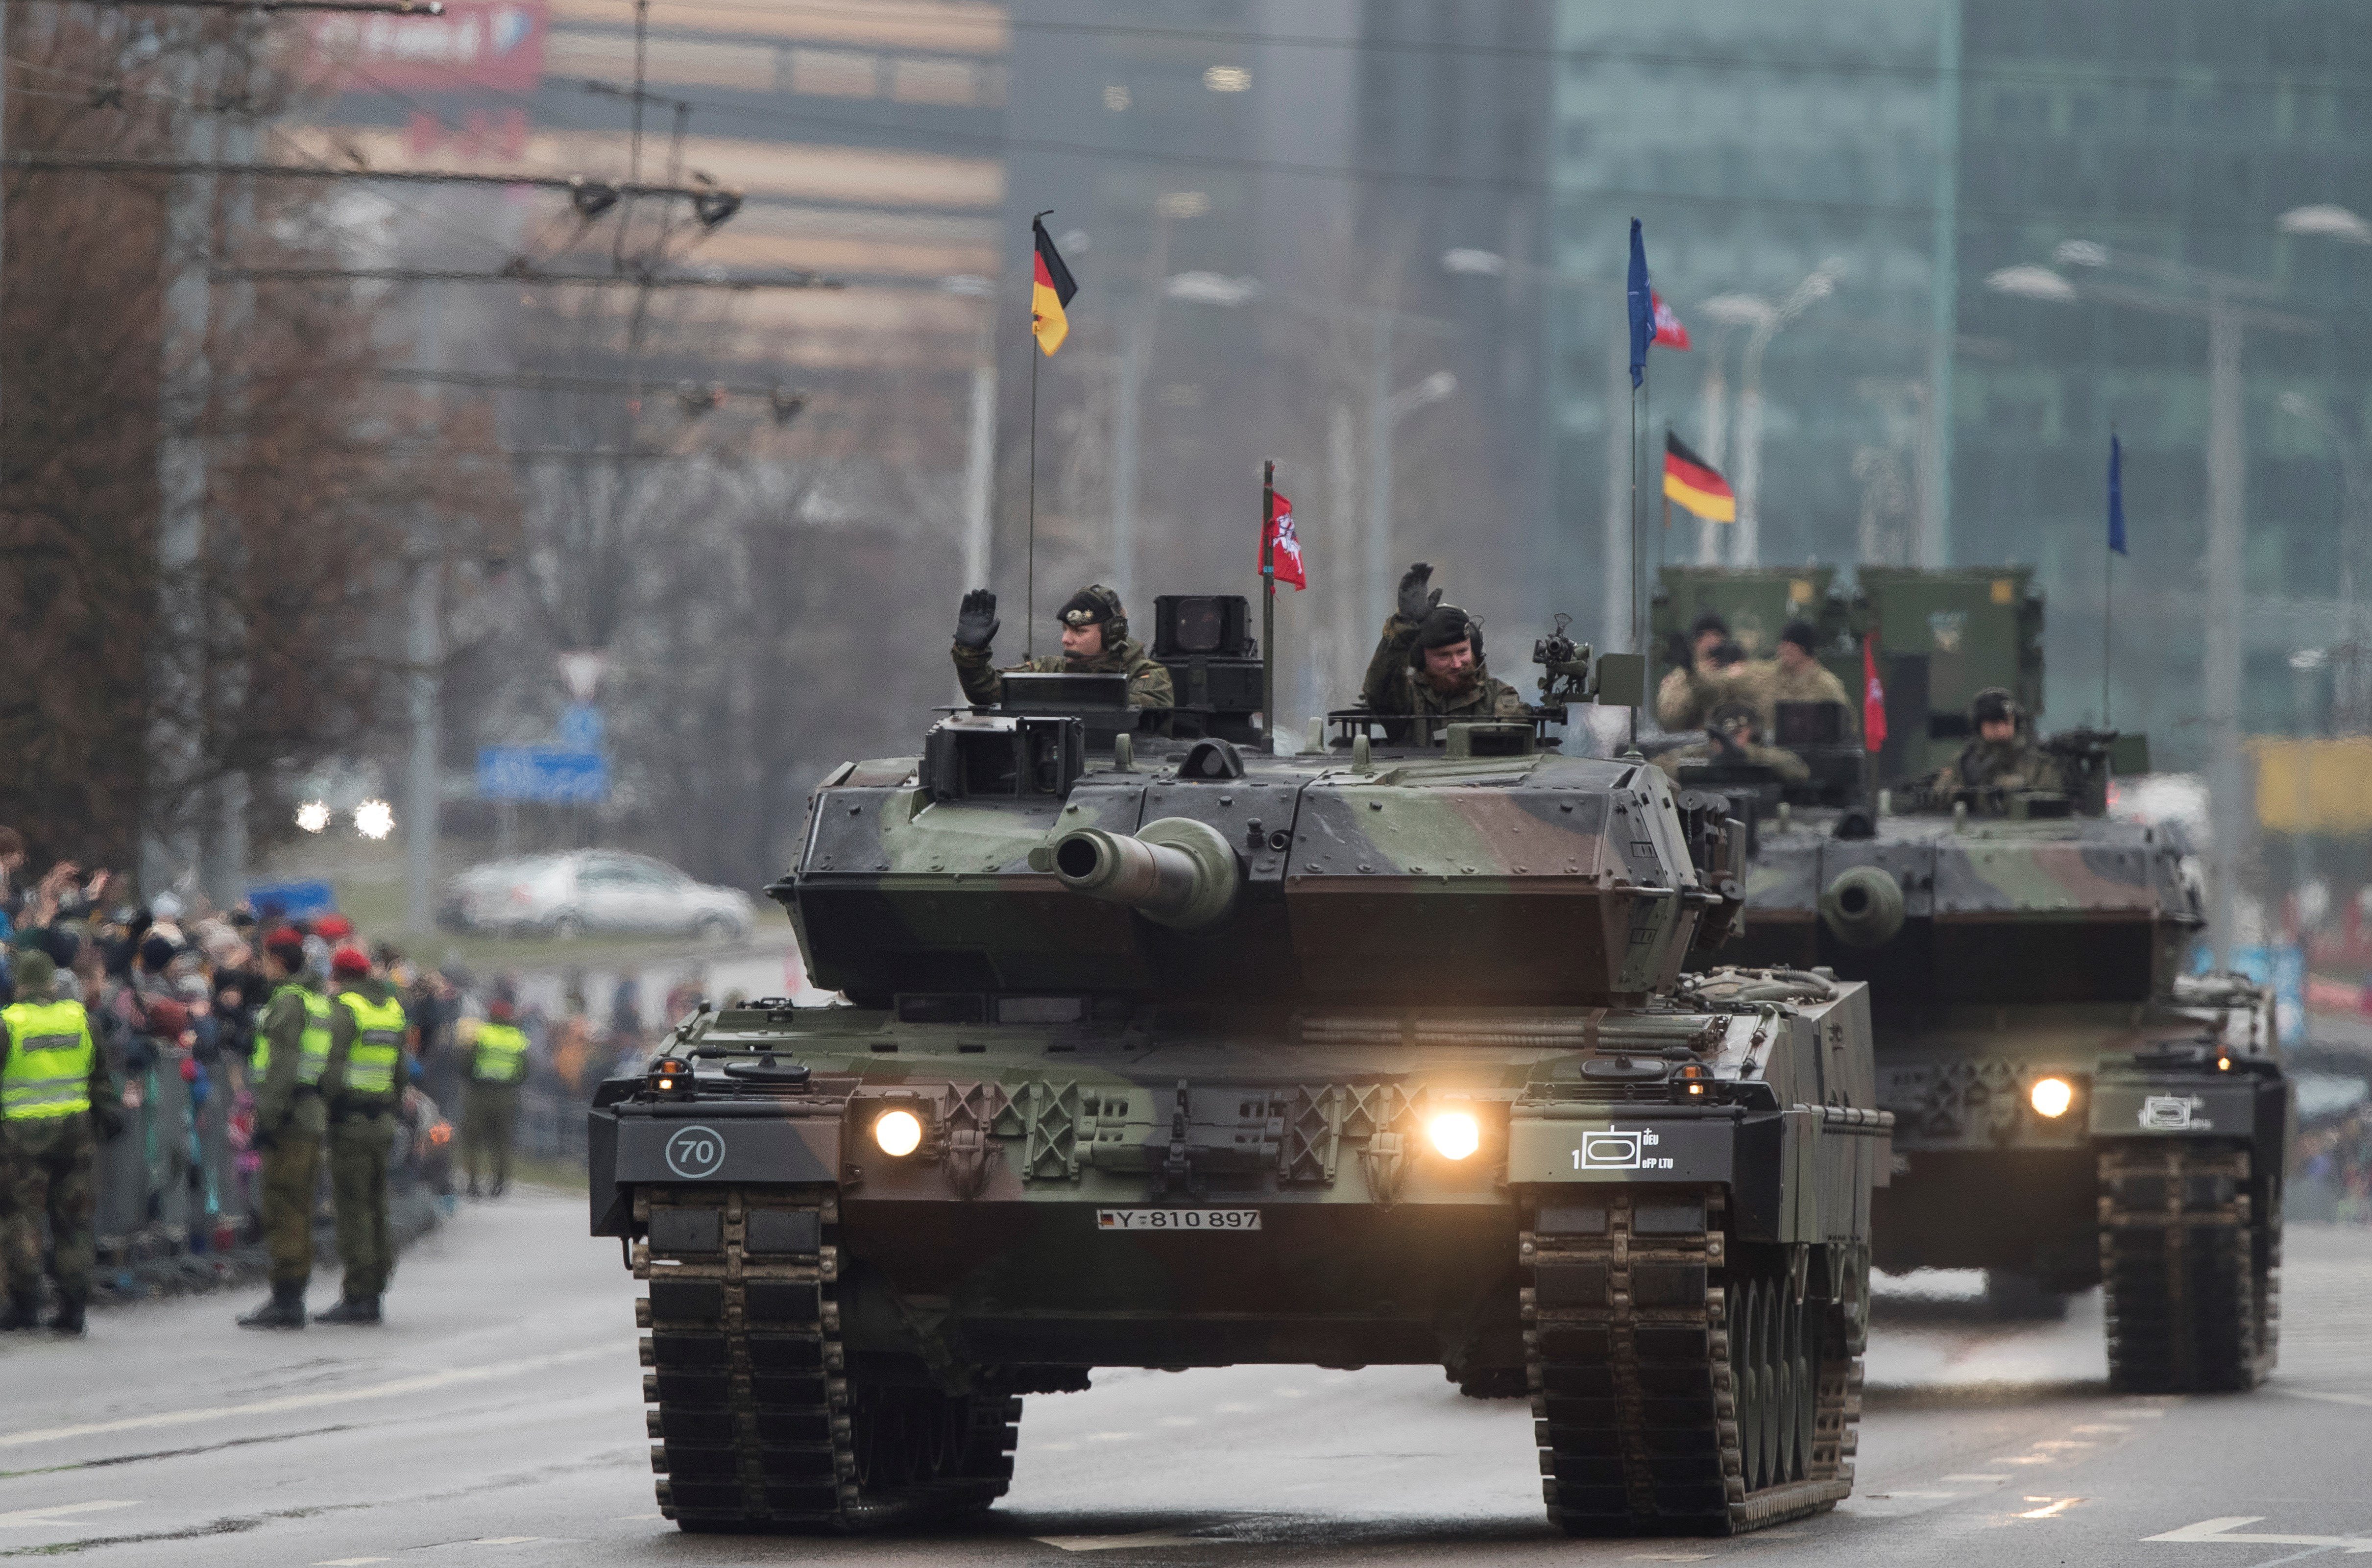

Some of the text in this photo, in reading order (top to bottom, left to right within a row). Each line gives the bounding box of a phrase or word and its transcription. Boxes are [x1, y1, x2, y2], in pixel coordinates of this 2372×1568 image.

[1643, 1134, 1659, 1146] DEU
[678, 1140, 714, 1163] 70
[1571, 1149, 1580, 1170] 1
[1658, 1158, 1673, 1169] LTU
[1209, 1211, 1258, 1228] 897
